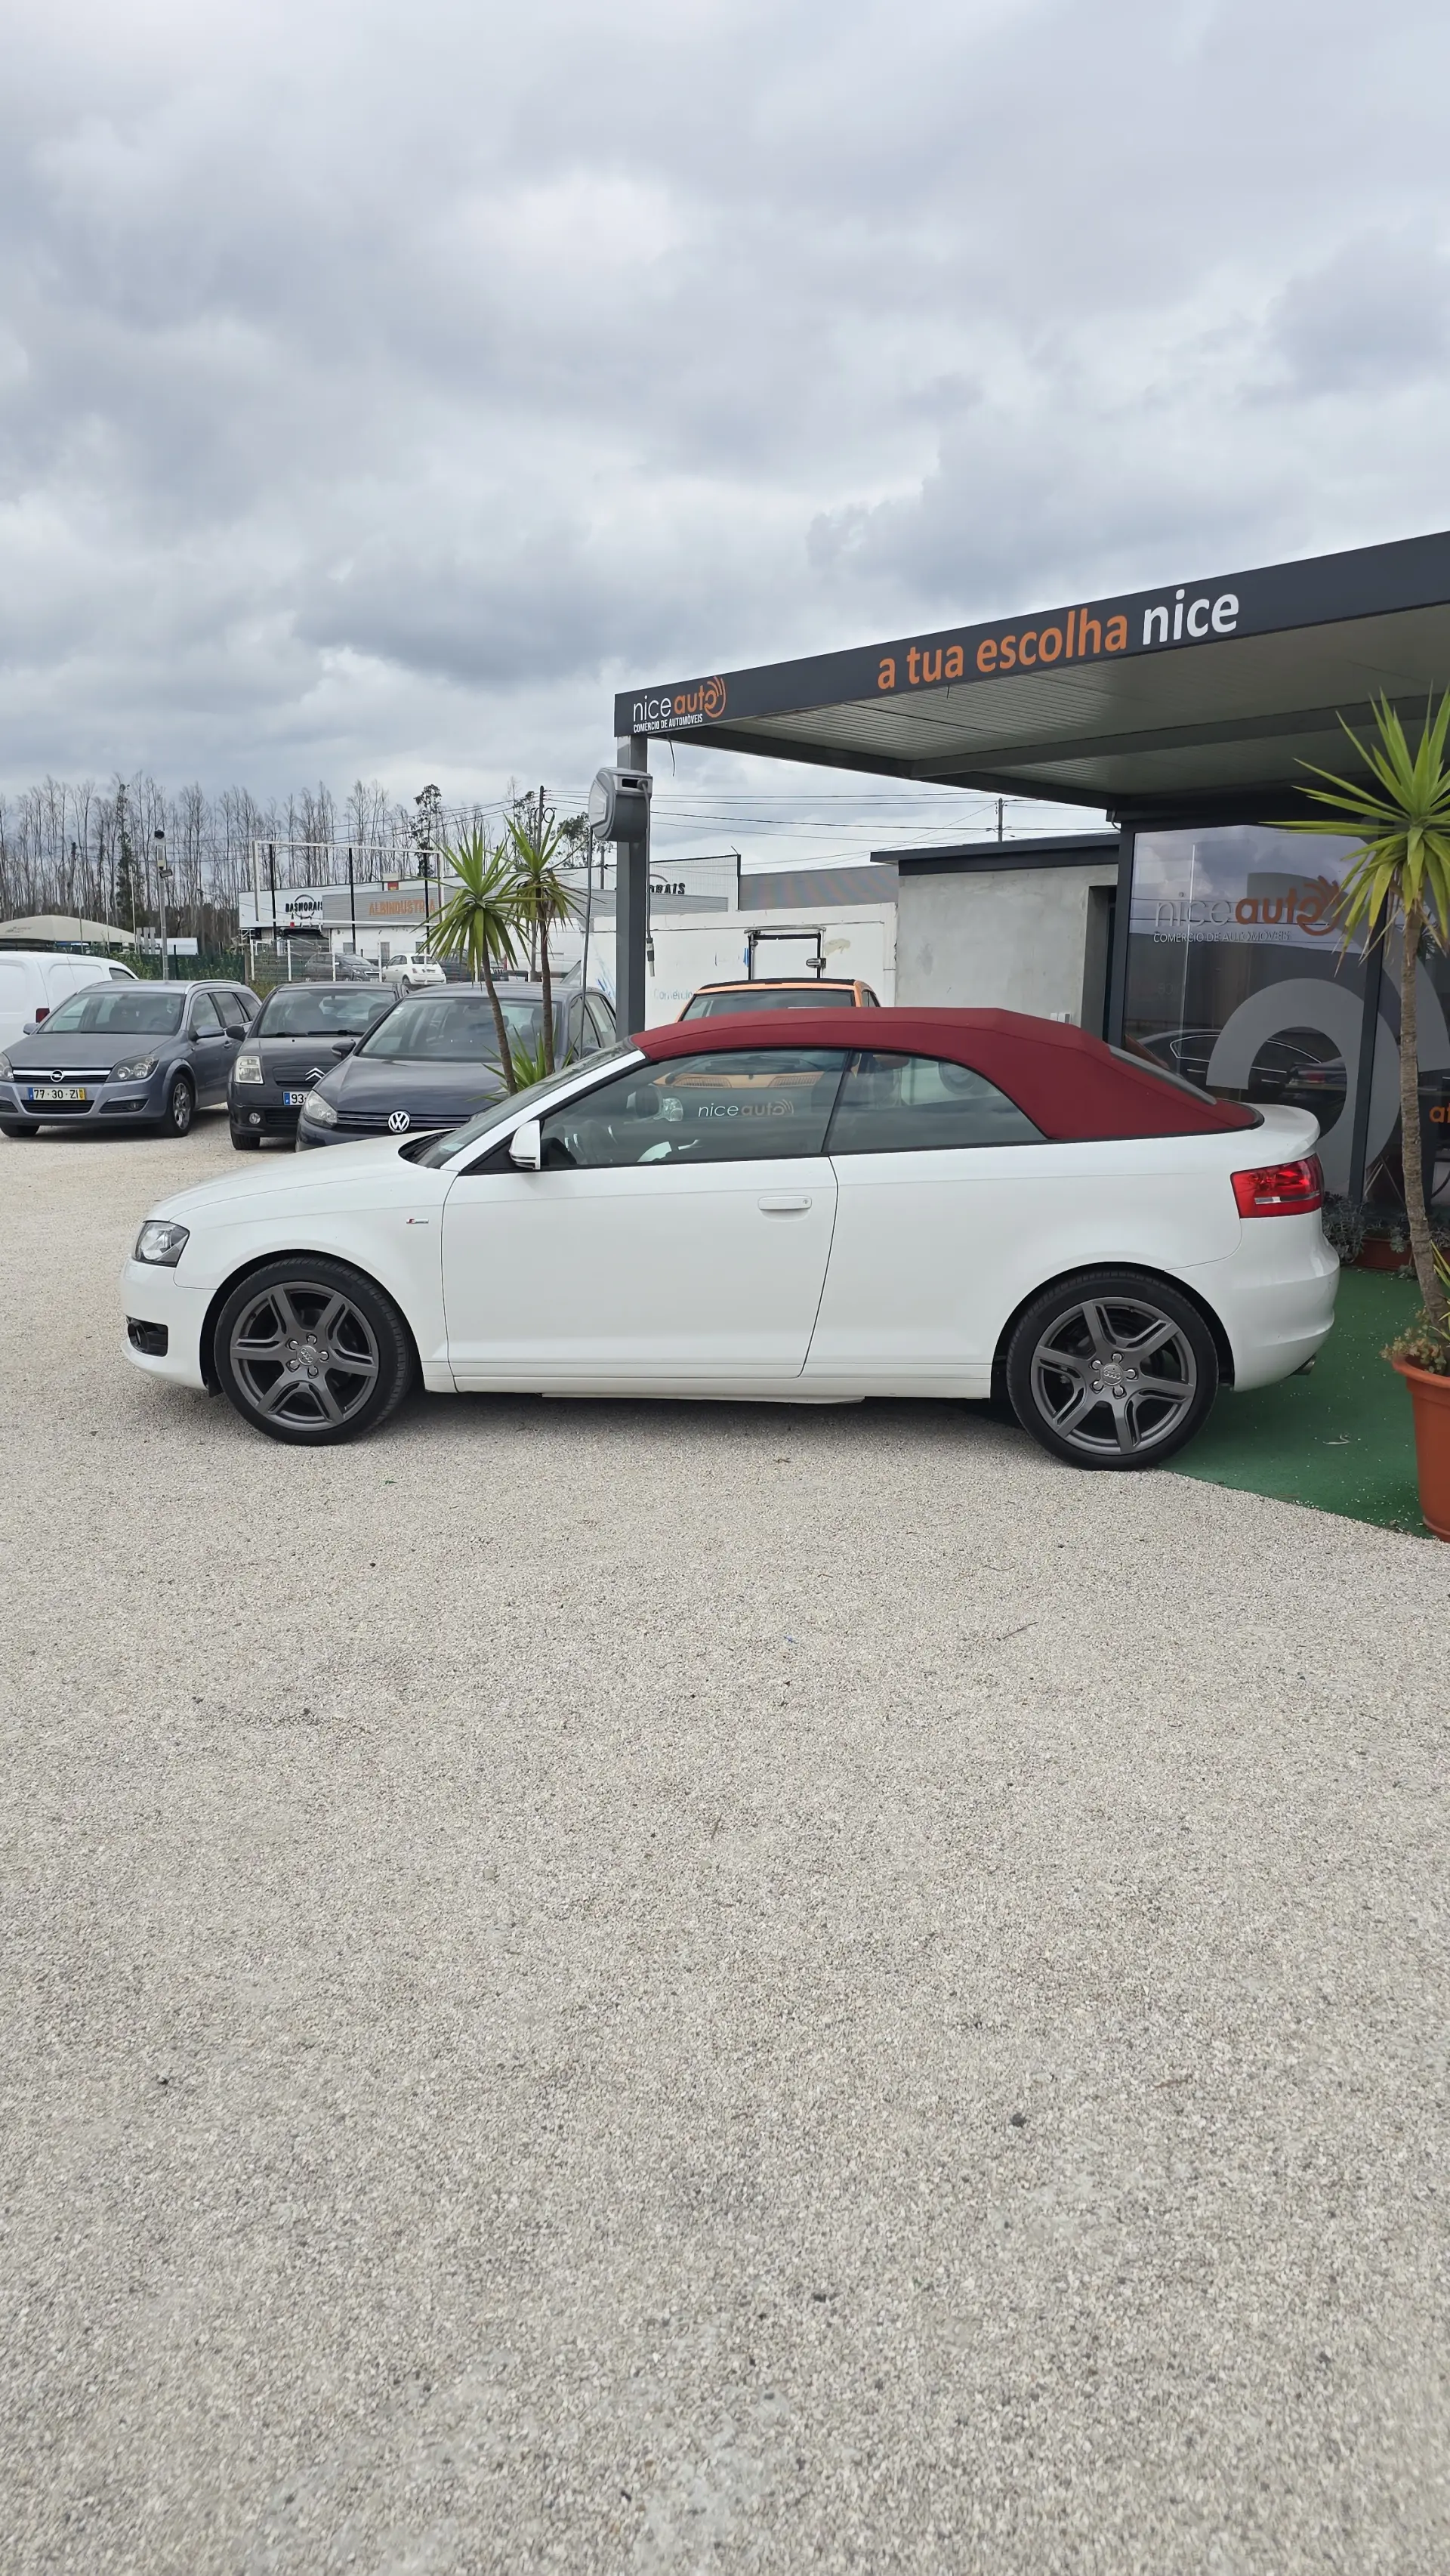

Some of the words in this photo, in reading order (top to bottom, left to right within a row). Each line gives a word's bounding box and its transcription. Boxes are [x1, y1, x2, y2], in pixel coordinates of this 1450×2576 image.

[878, 657, 896, 690] a
[906, 645, 964, 684] tua
[976, 607, 1128, 671] escolha
[1142, 589, 1239, 646] nice
[661, 718, 668, 729] DE
[1206, 931, 1220, 943] DE
